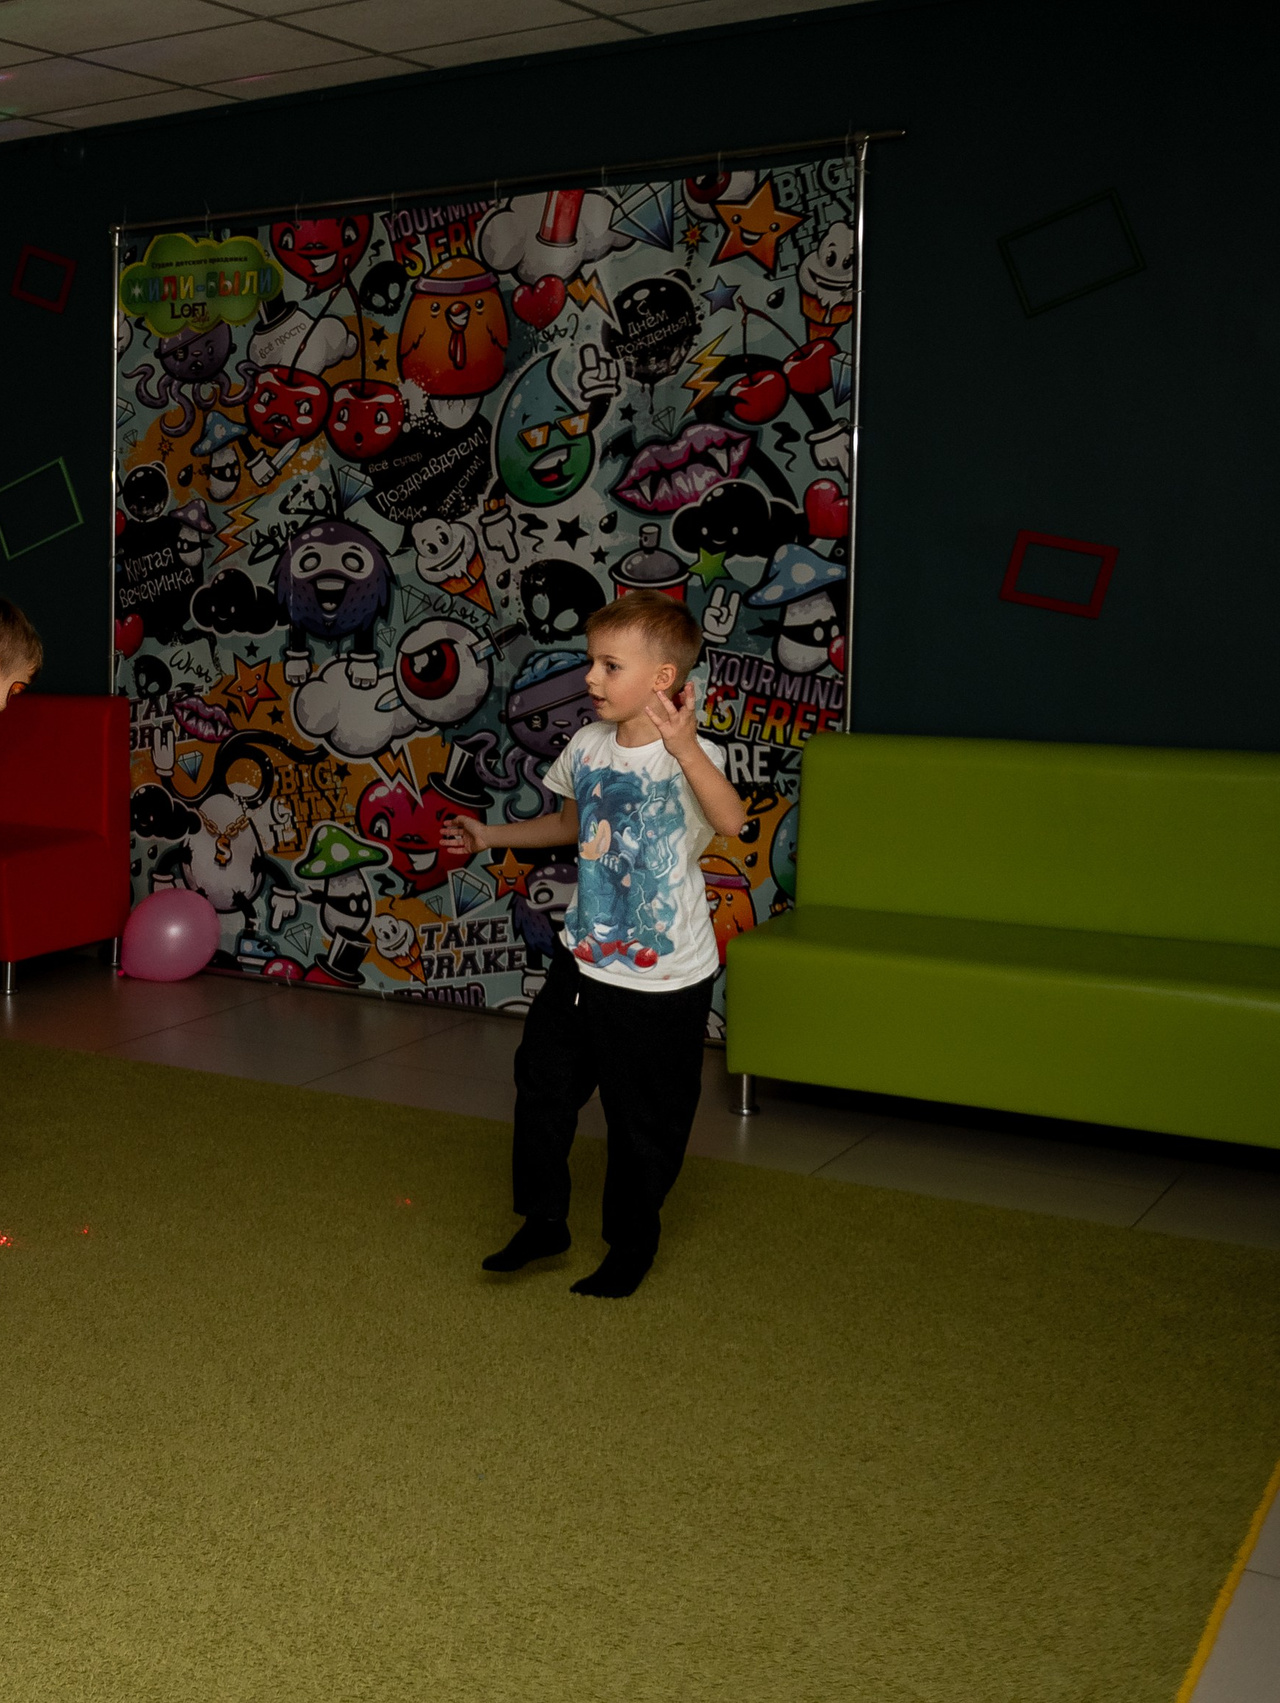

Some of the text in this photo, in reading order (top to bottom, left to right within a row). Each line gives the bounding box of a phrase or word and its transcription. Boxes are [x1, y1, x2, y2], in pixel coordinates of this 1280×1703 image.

[773, 158, 854, 209] BIG
[382, 206, 445, 242] YOUR
[393, 213, 484, 277] IS FR
[127, 267, 273, 304] ЖИЛИ-БЫЛИ
[170, 302, 206, 319] LOFT
[118, 567, 196, 608] Вечеринка
[708, 651, 845, 711] YOUR MIND
[740, 695, 840, 749] FREE
[275, 759, 338, 796] BIG
[270, 787, 348, 825] CITY
[421, 917, 509, 951] TAKE
[412, 944, 527, 982] BRAKE
